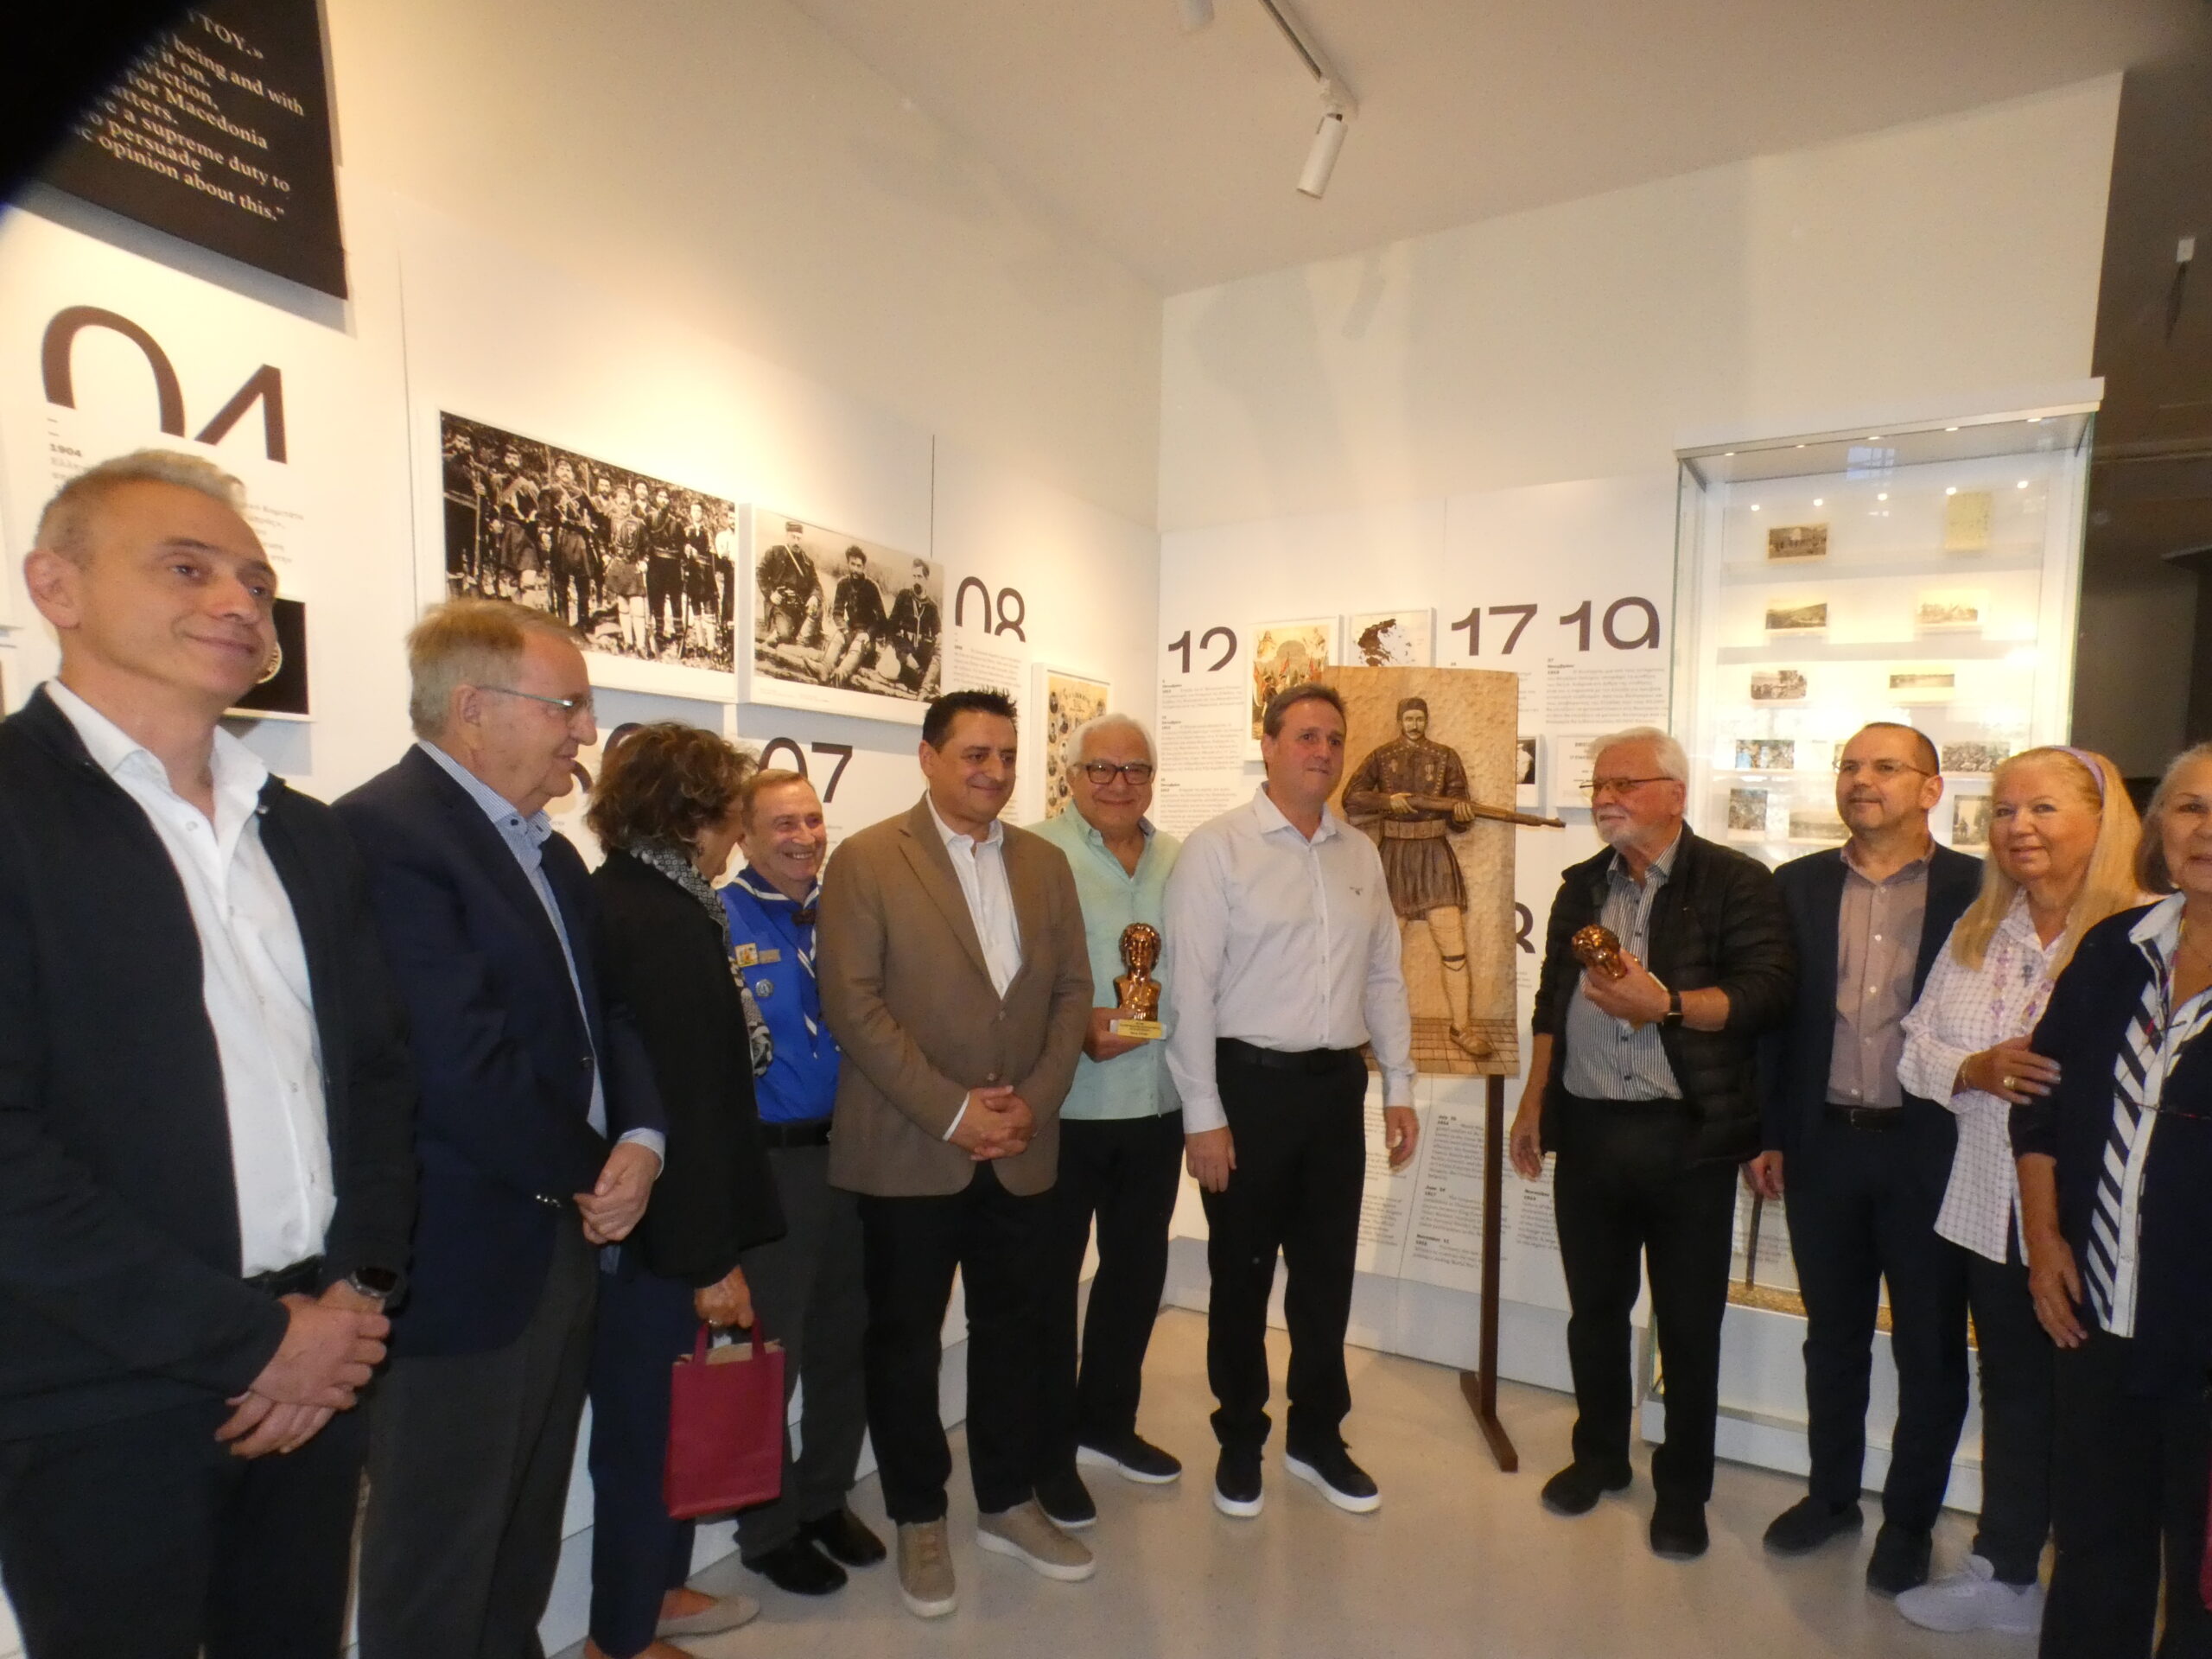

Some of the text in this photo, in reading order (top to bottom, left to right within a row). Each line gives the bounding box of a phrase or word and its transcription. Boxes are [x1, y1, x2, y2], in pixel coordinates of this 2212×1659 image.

[174, 34, 227, 81] being
[231, 70, 264, 97] and
[267, 86, 305, 117] with
[108, 117, 202, 172] persuade
[164, 84, 268, 149] Macedonia
[99, 133, 179, 181] opinion
[183, 171, 236, 205] about
[124, 108, 137, 124] a
[141, 116, 225, 166] supreme
[229, 155, 269, 187] duty
[272, 175, 291, 194] to
[1167, 626, 1237, 673] 12
[1451, 603, 1538, 657] 17
